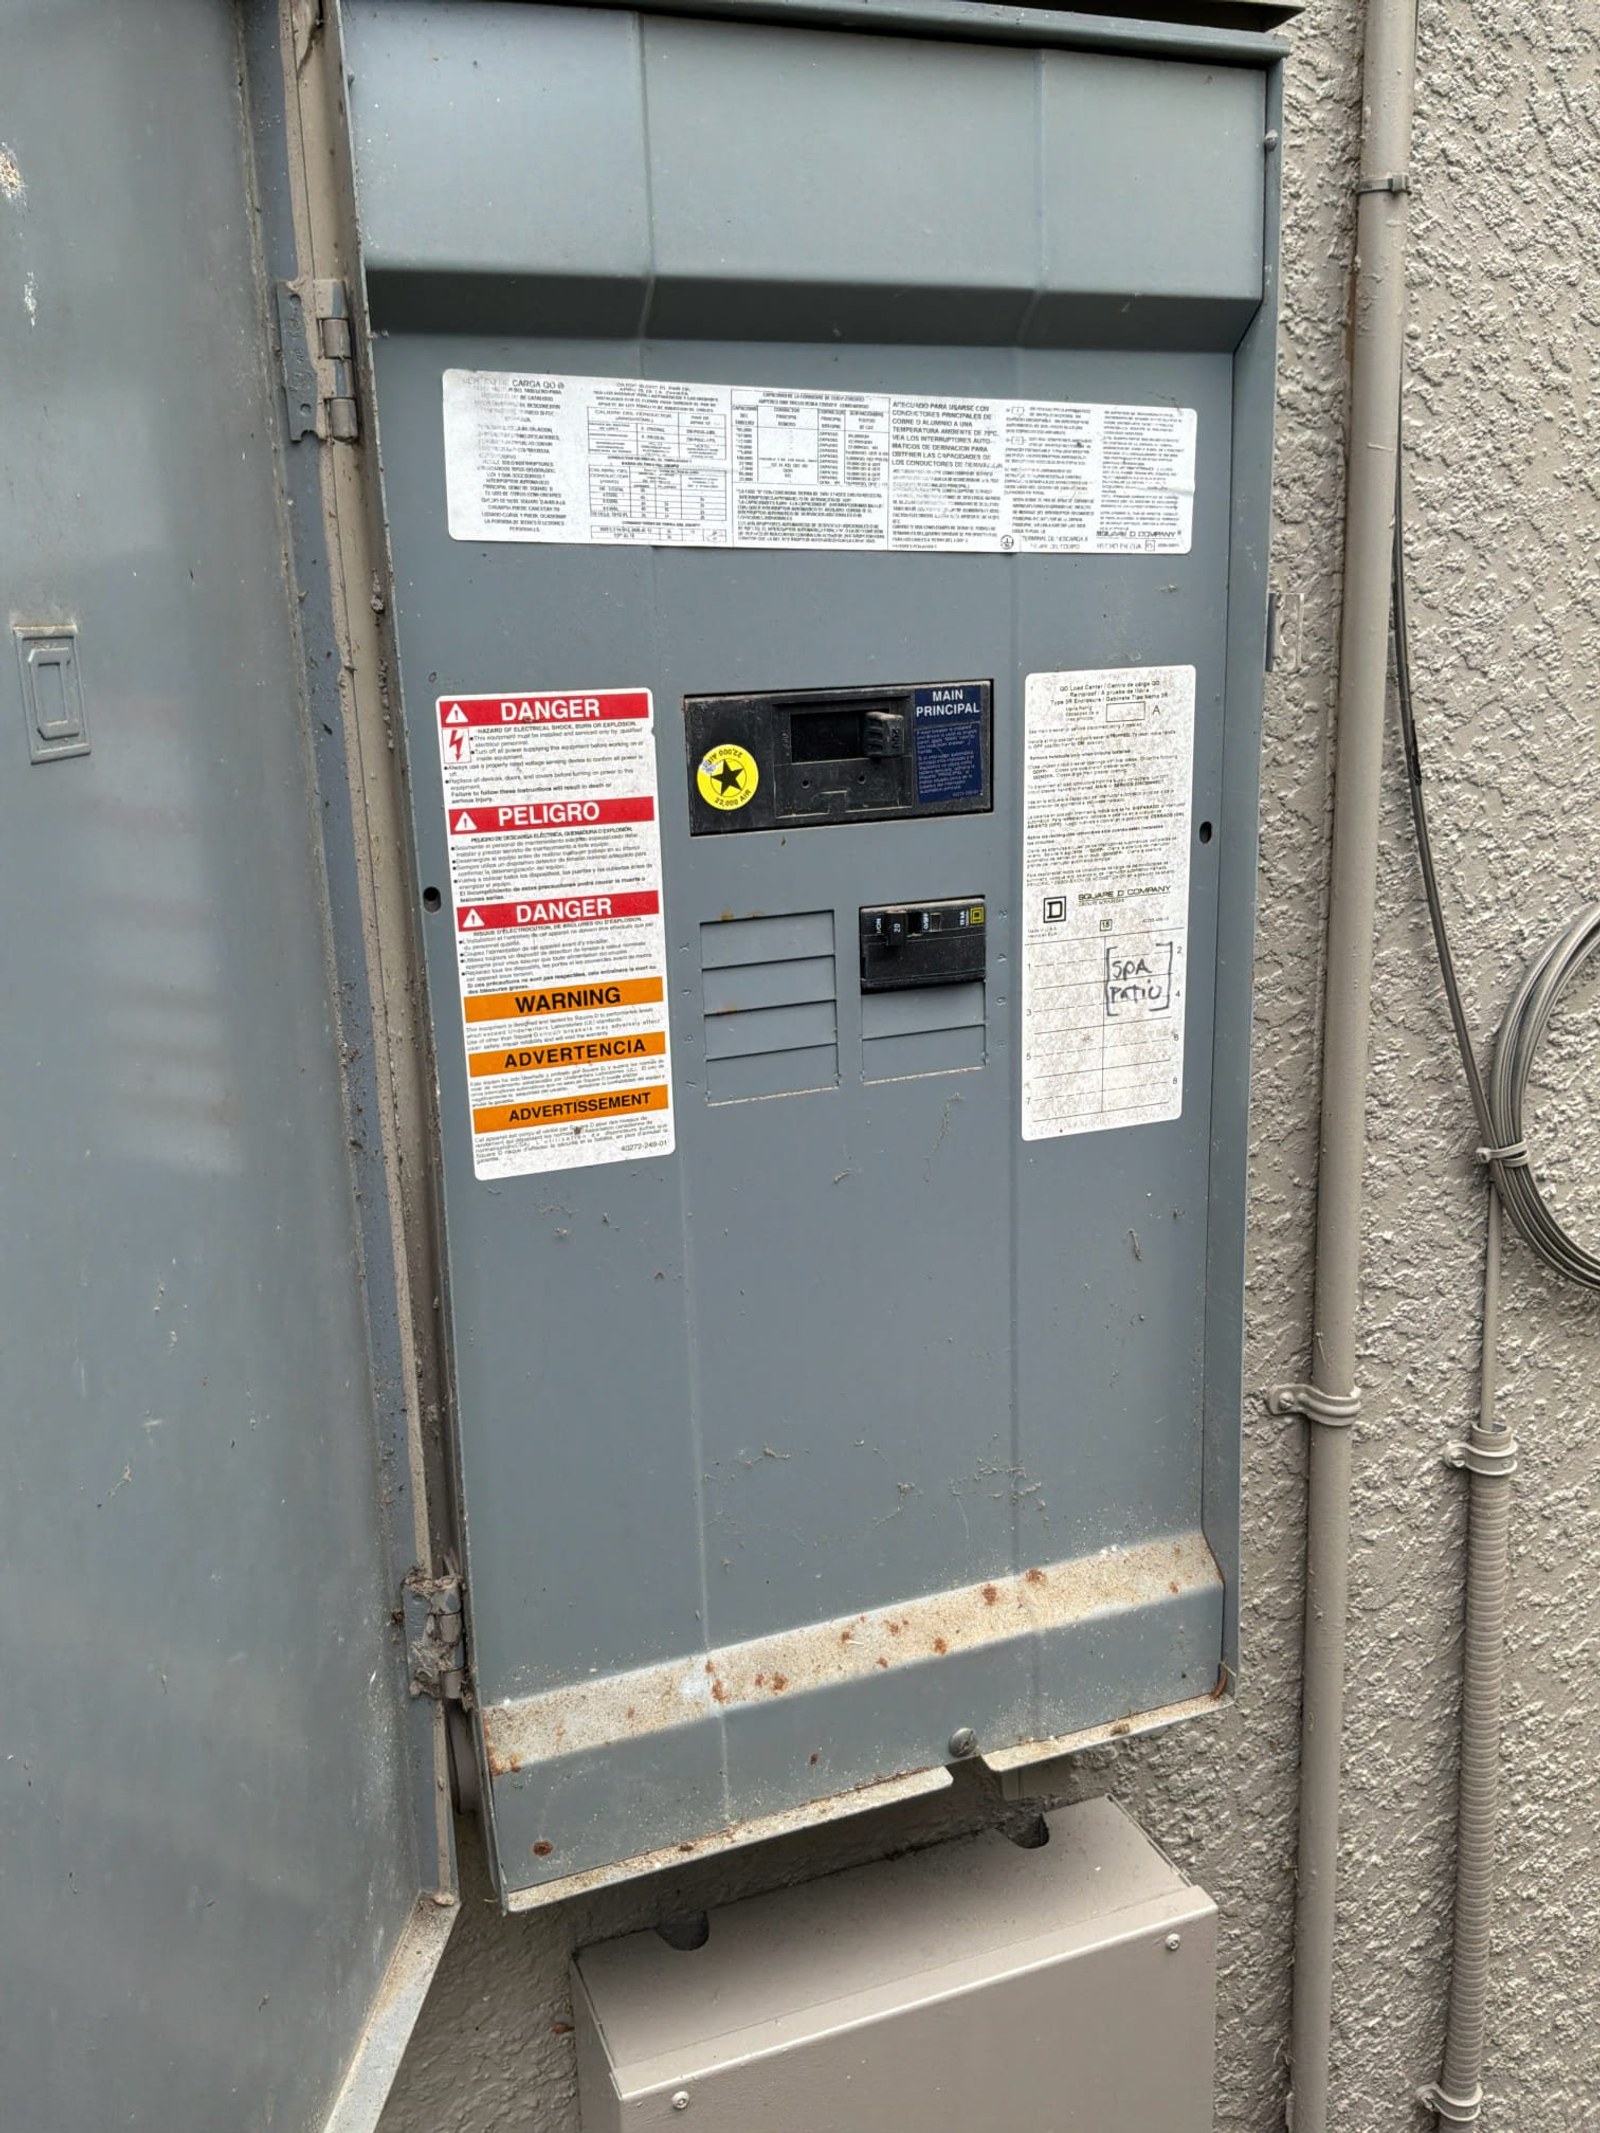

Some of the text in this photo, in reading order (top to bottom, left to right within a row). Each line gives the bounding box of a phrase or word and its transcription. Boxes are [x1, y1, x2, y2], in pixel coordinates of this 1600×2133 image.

[511, 379, 540, 388] CARGA
[930, 402, 946, 410] PARA
[892, 409, 939, 417] CONDUCTORES
[941, 411, 981, 419] PRINCIPALES
[892, 425, 939, 434] TEMPERATURA
[920, 435, 971, 444] INTERRUPTORES
[891, 450, 921, 458] OBTENER
[937, 452, 981, 460] CAPACIDADES
[906, 459, 952, 467] CONDUCTORES
[1138, 530, 1175, 538] COMPANY
[932, 689, 964, 702] MAIN
[1050, 698, 1063, 706] Type
[501, 699, 600, 721] DANGER
[916, 703, 980, 717] PRINCIPAL
[1152, 704, 1160, 715] A
[715, 789, 751, 806] 22,000 AIR
[498, 801, 600, 826] PELIGRO
[1078, 884, 1171, 901] SQUARE D COMPANY
[516, 898, 612, 923] DANGER
[1176, 945, 1182, 953] 2
[515, 987, 621, 1013] WARNING
[1026, 1008, 1031, 1016] 3
[505, 1039, 646, 1068] ADVERTENCIA
[509, 1092, 651, 1122] ADVERTISSEMENT
